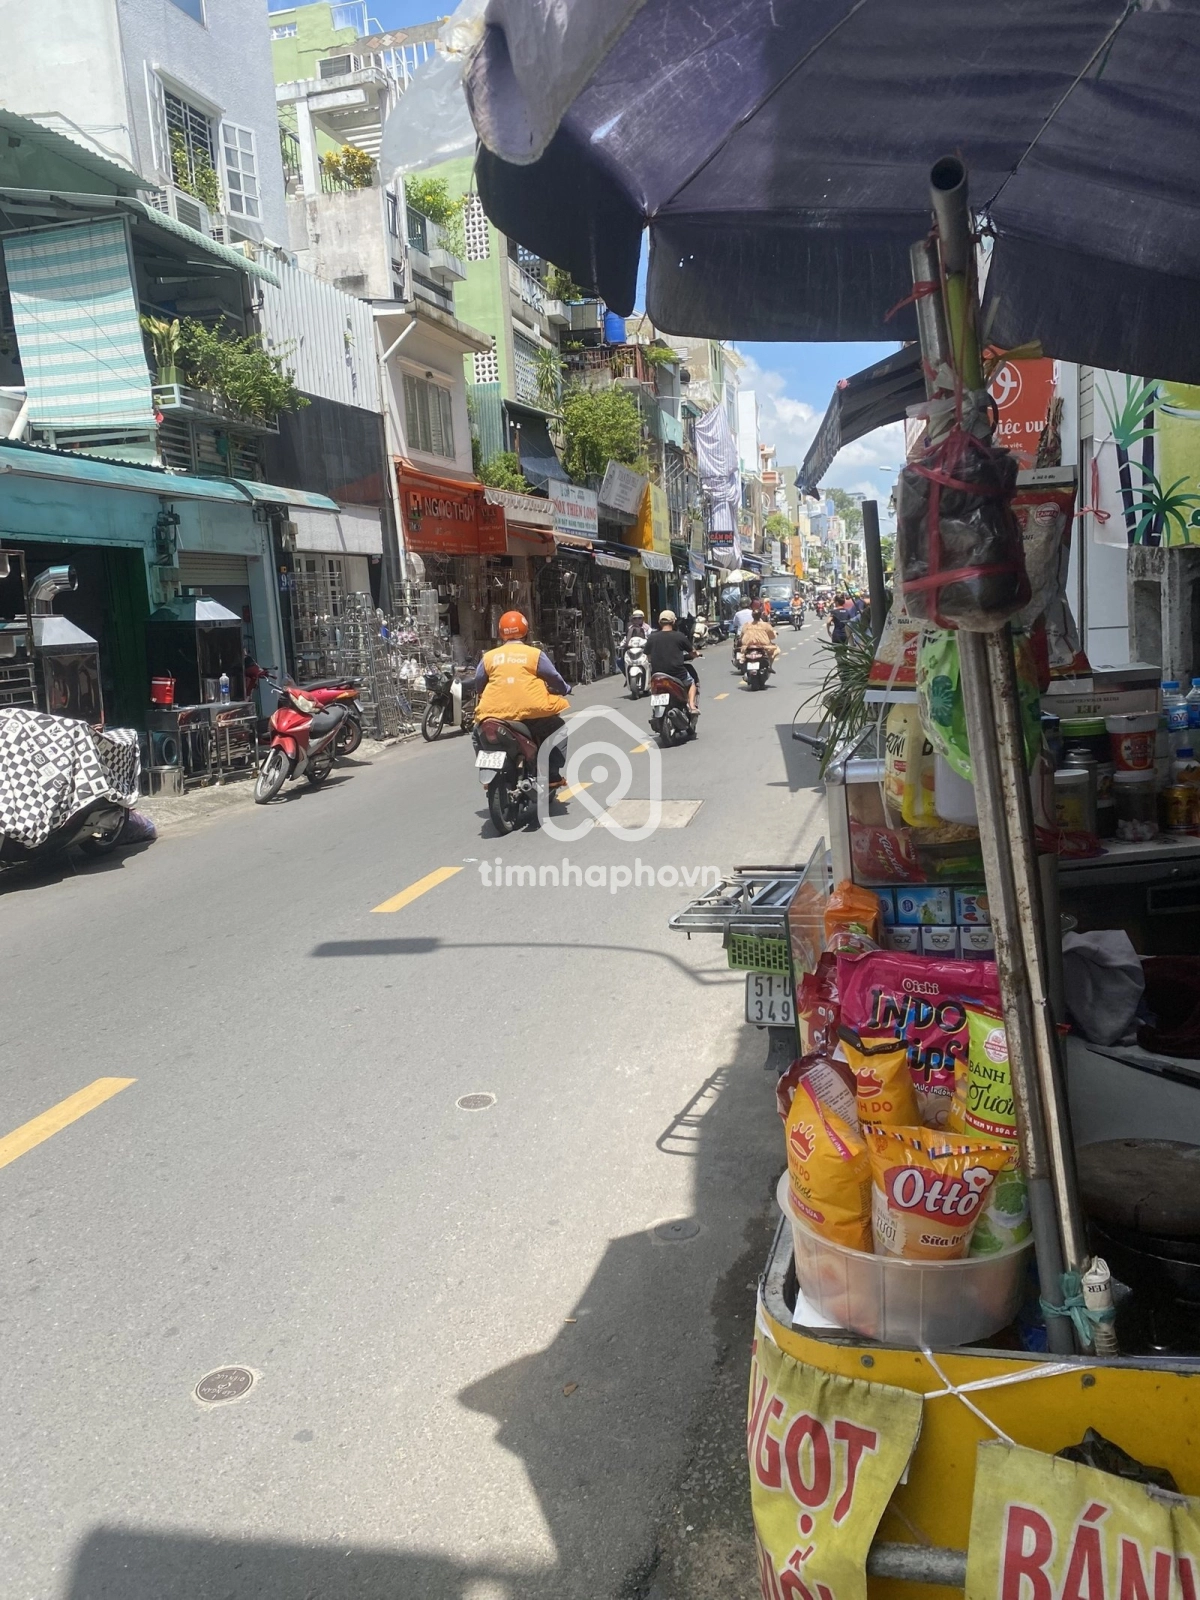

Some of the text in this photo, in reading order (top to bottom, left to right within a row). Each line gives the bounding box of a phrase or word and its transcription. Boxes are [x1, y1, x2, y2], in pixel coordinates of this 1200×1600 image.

[994, 418, 1022, 439] iệc
[876, 849, 894, 874] HEO
[902, 978, 939, 995] Oishi
[867, 988, 967, 1034] INDO
[895, 1029, 964, 1084] ips
[968, 1059, 1006, 1084] BÁNH
[995, 1126, 1010, 1136] SỮA
[893, 1168, 980, 1217] Otto
[920, 1234, 949, 1246] Sữa
[1002, 1503, 1197, 1600] BÁN
